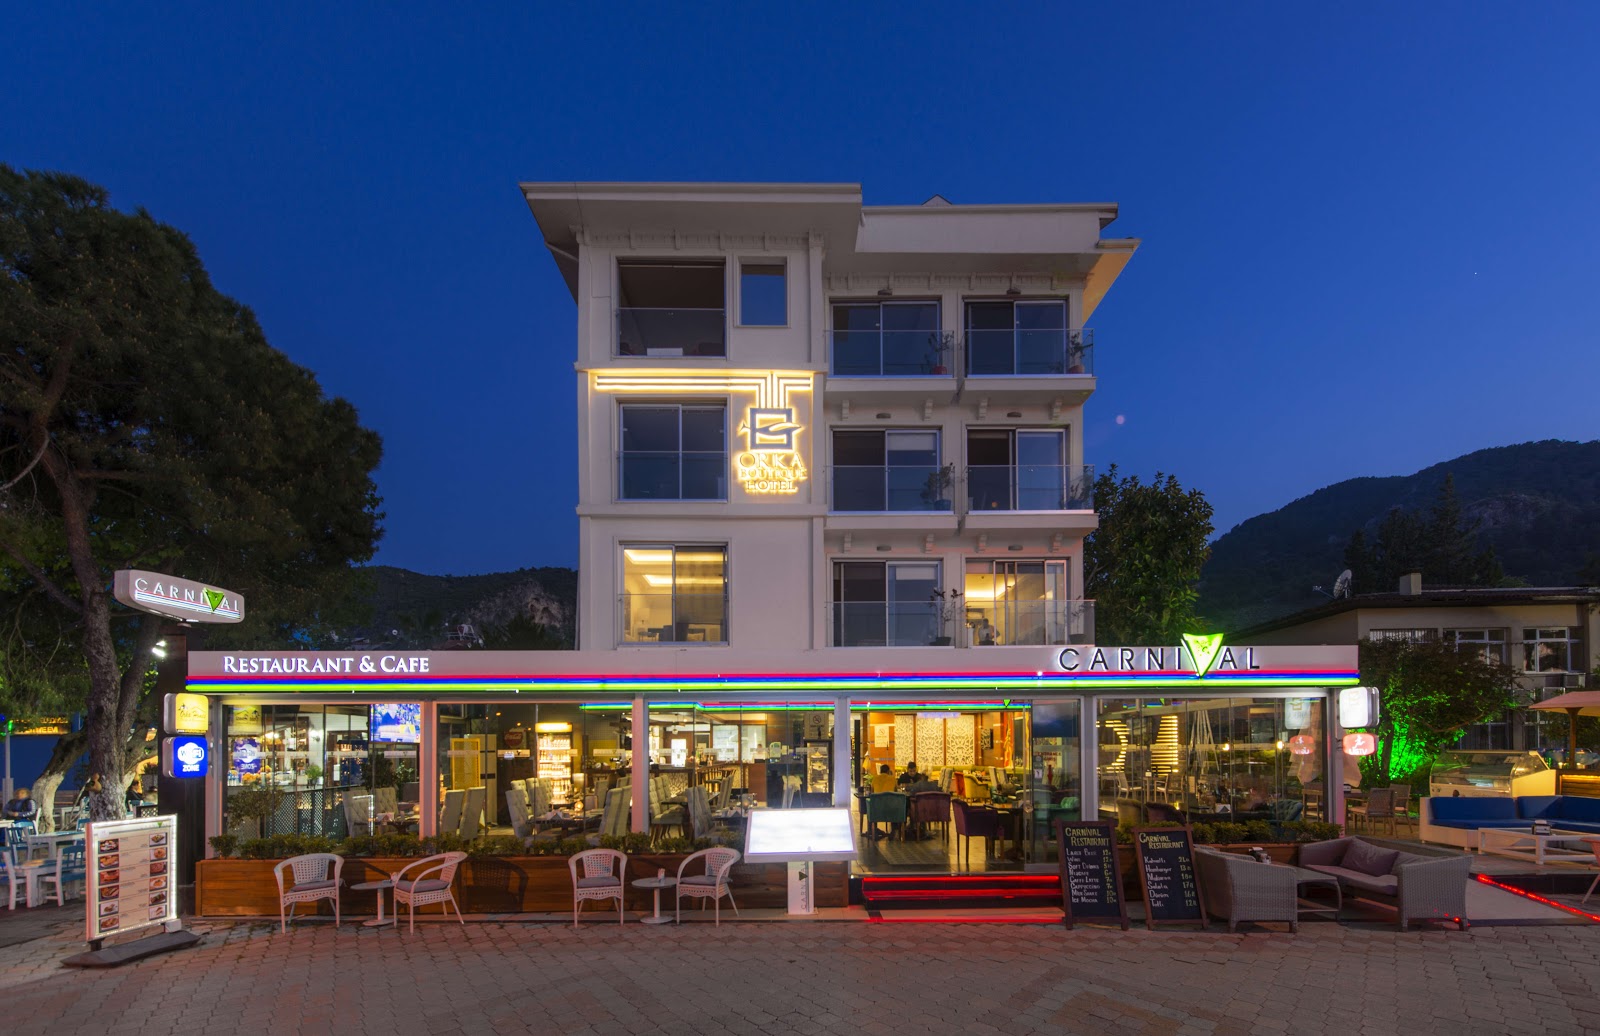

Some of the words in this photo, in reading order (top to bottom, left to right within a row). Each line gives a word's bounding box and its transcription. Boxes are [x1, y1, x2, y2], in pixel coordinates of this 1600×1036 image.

[739, 452, 805, 469] ORKA
[739, 468, 808, 479] BOUTIQUE
[746, 480, 798, 492] HOTEL
[135, 577, 240, 612] CARNIVAL
[1058, 633, 1260, 677] CARNIVAL
[223, 655, 354, 673] RESTAURANT
[359, 655, 377, 673] &
[379, 655, 430, 673] CAFE
[182, 764, 200, 772] ZONE
